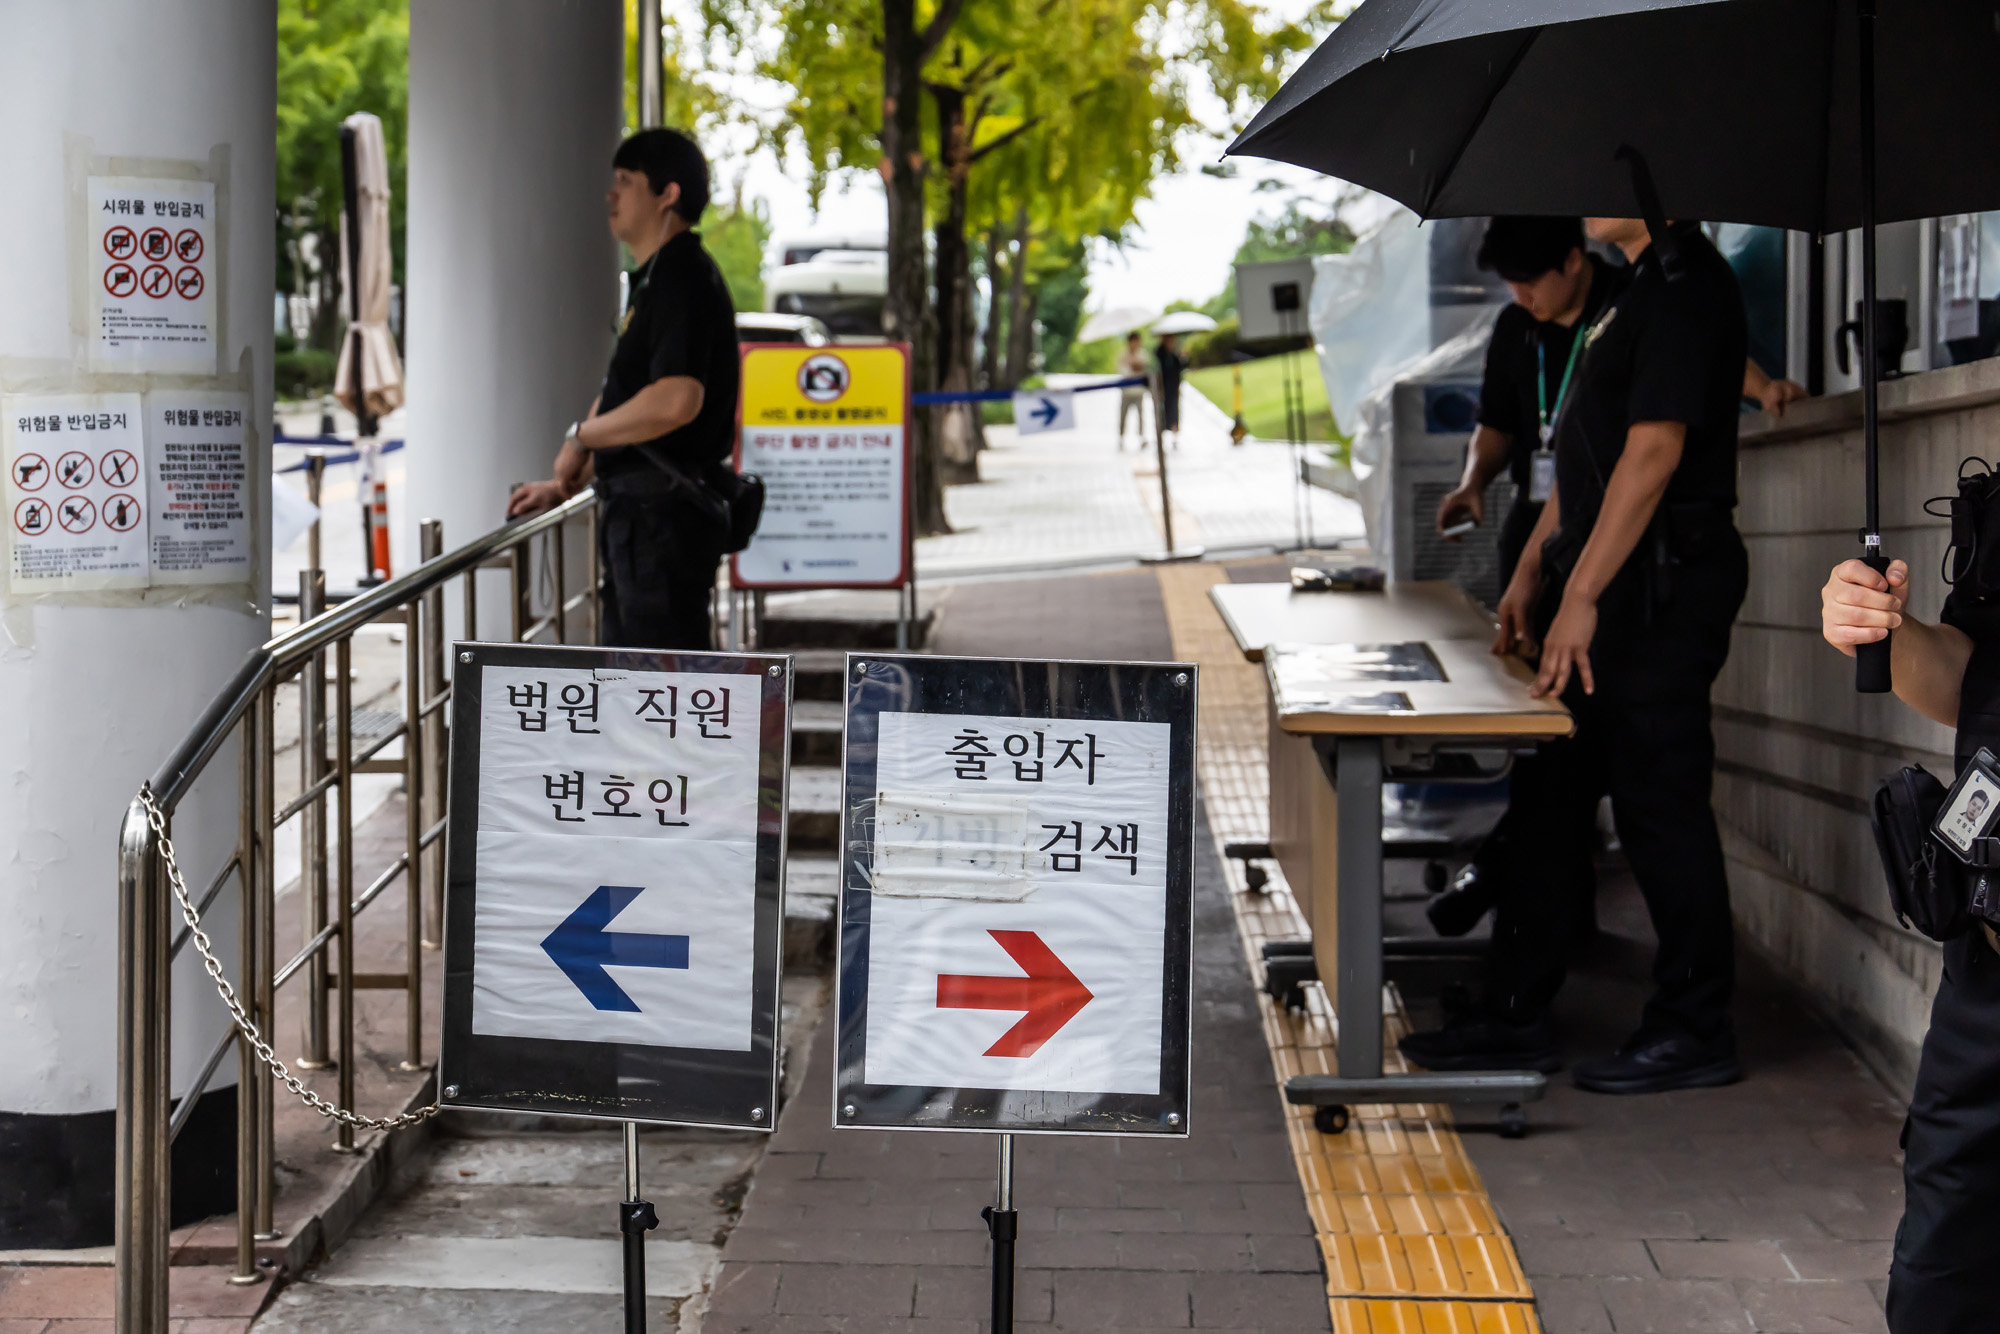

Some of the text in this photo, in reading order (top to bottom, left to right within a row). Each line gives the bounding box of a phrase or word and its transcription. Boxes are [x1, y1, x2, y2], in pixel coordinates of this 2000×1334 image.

[103, 199, 205, 218] 시위물 반입금지
[18, 413, 127, 432] 위험물 반입금지
[164, 409, 242, 427] 위험물 반입금지
[754, 433, 892, 450] 무단 촬영 금지 안내
[506, 680, 732, 739] 법원 직원
[945, 728, 1106, 786] 출입자
[542, 770, 690, 827] 변호인
[1040, 820, 1139, 876] 검색
